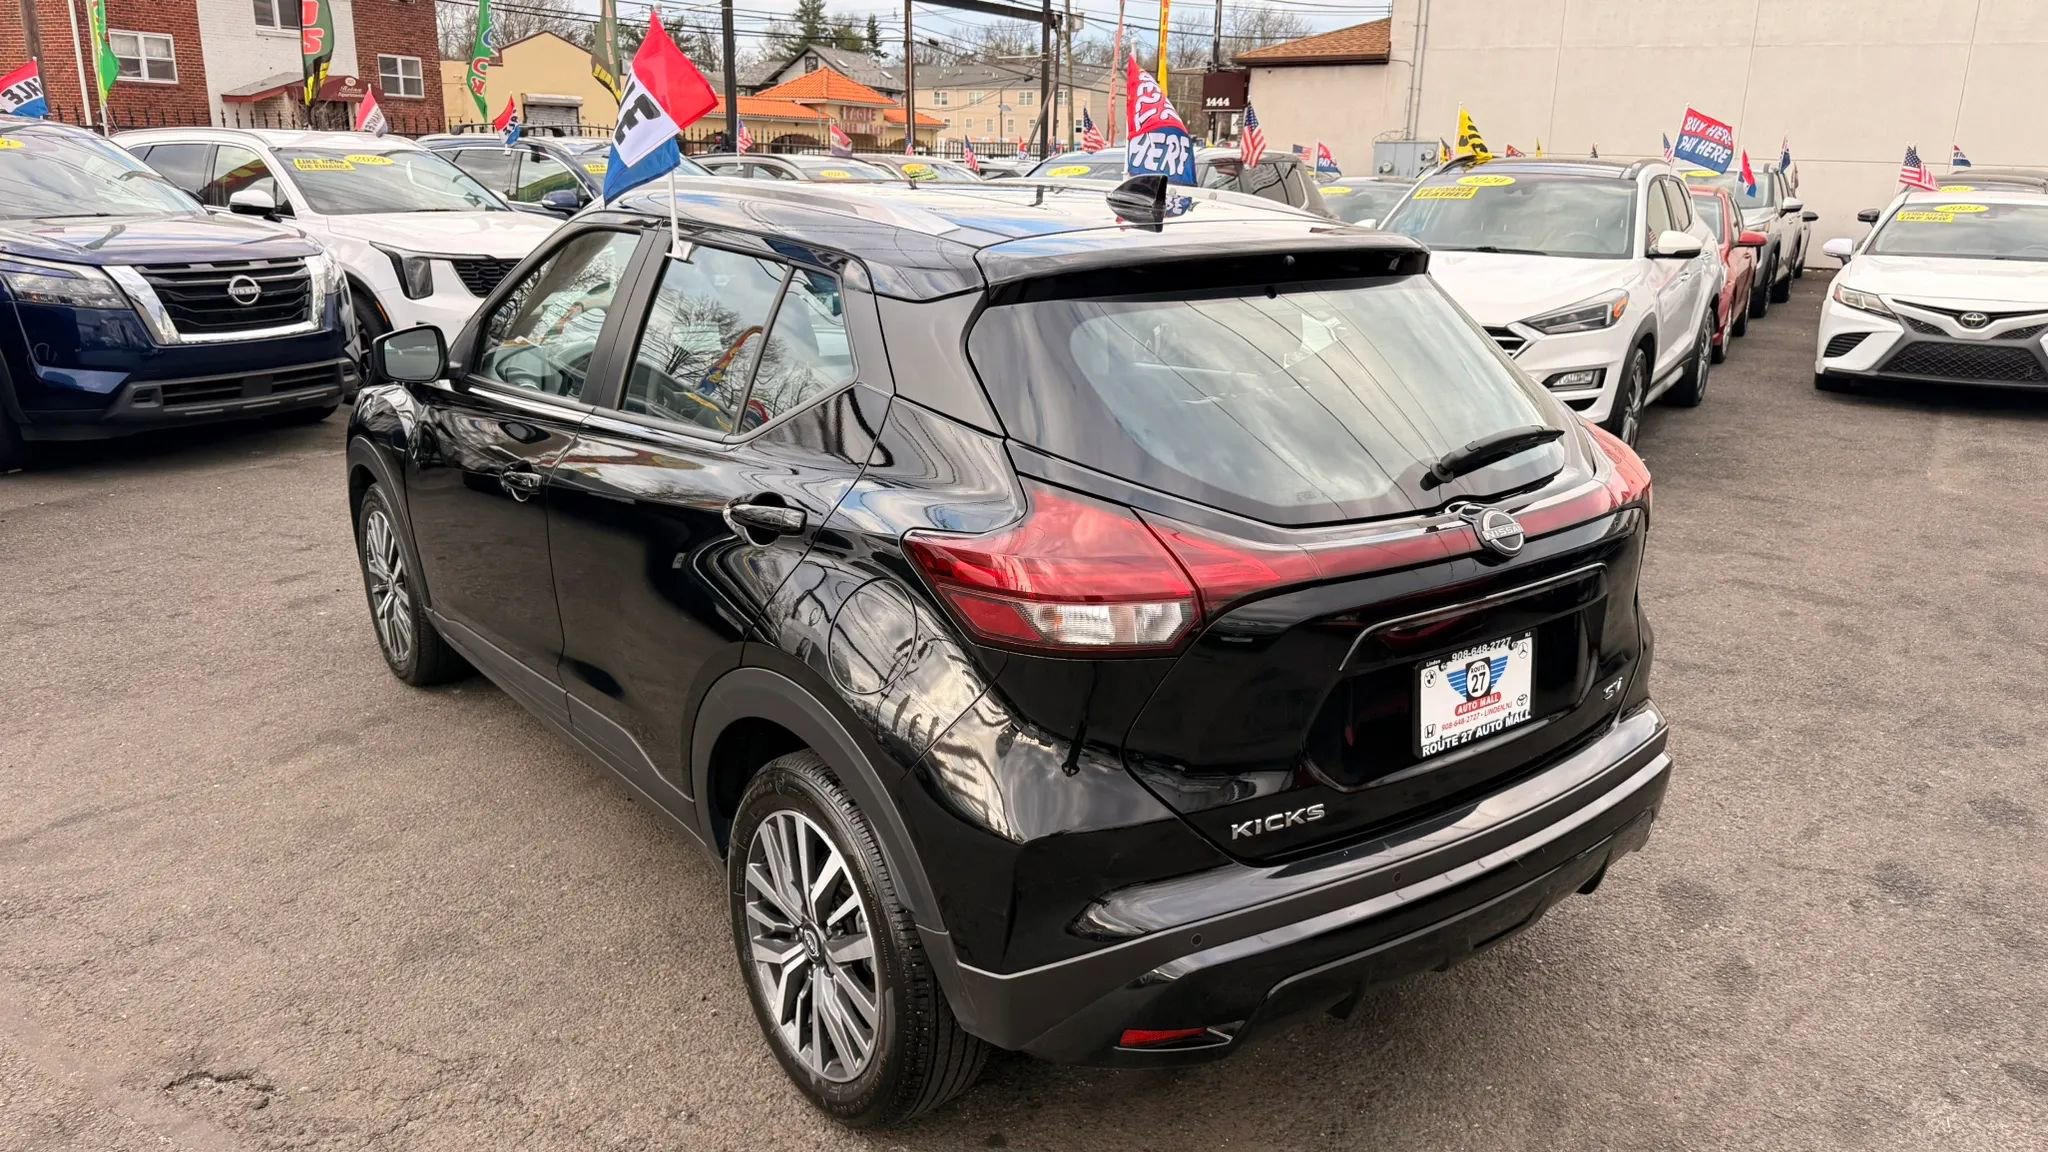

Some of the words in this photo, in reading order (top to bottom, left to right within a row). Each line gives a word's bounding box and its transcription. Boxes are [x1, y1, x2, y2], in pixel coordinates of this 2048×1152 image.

[1206, 97, 1230, 107] 1444
[1684, 116, 1708, 133] BUY
[1678, 135, 1699, 152] PAY
[1695, 140, 1732, 164] HERE
[1452, 637, 1512, 661] 908-648-2727
[1470, 664, 1486, 674] ROUTE
[1471, 672, 1486, 694] 27
[1457, 701, 1478, 716] AUTO
[1480, 693, 1499, 708] MALL
[1441, 712, 1480, 731] 908-648-2727
[1422, 736, 1459, 758] ROUTE
[1461, 730, 1473, 743] 27
[1475, 722, 1503, 738] AUTO
[1505, 711, 1531, 726] MALL
[1231, 803, 1325, 840] KICKS
